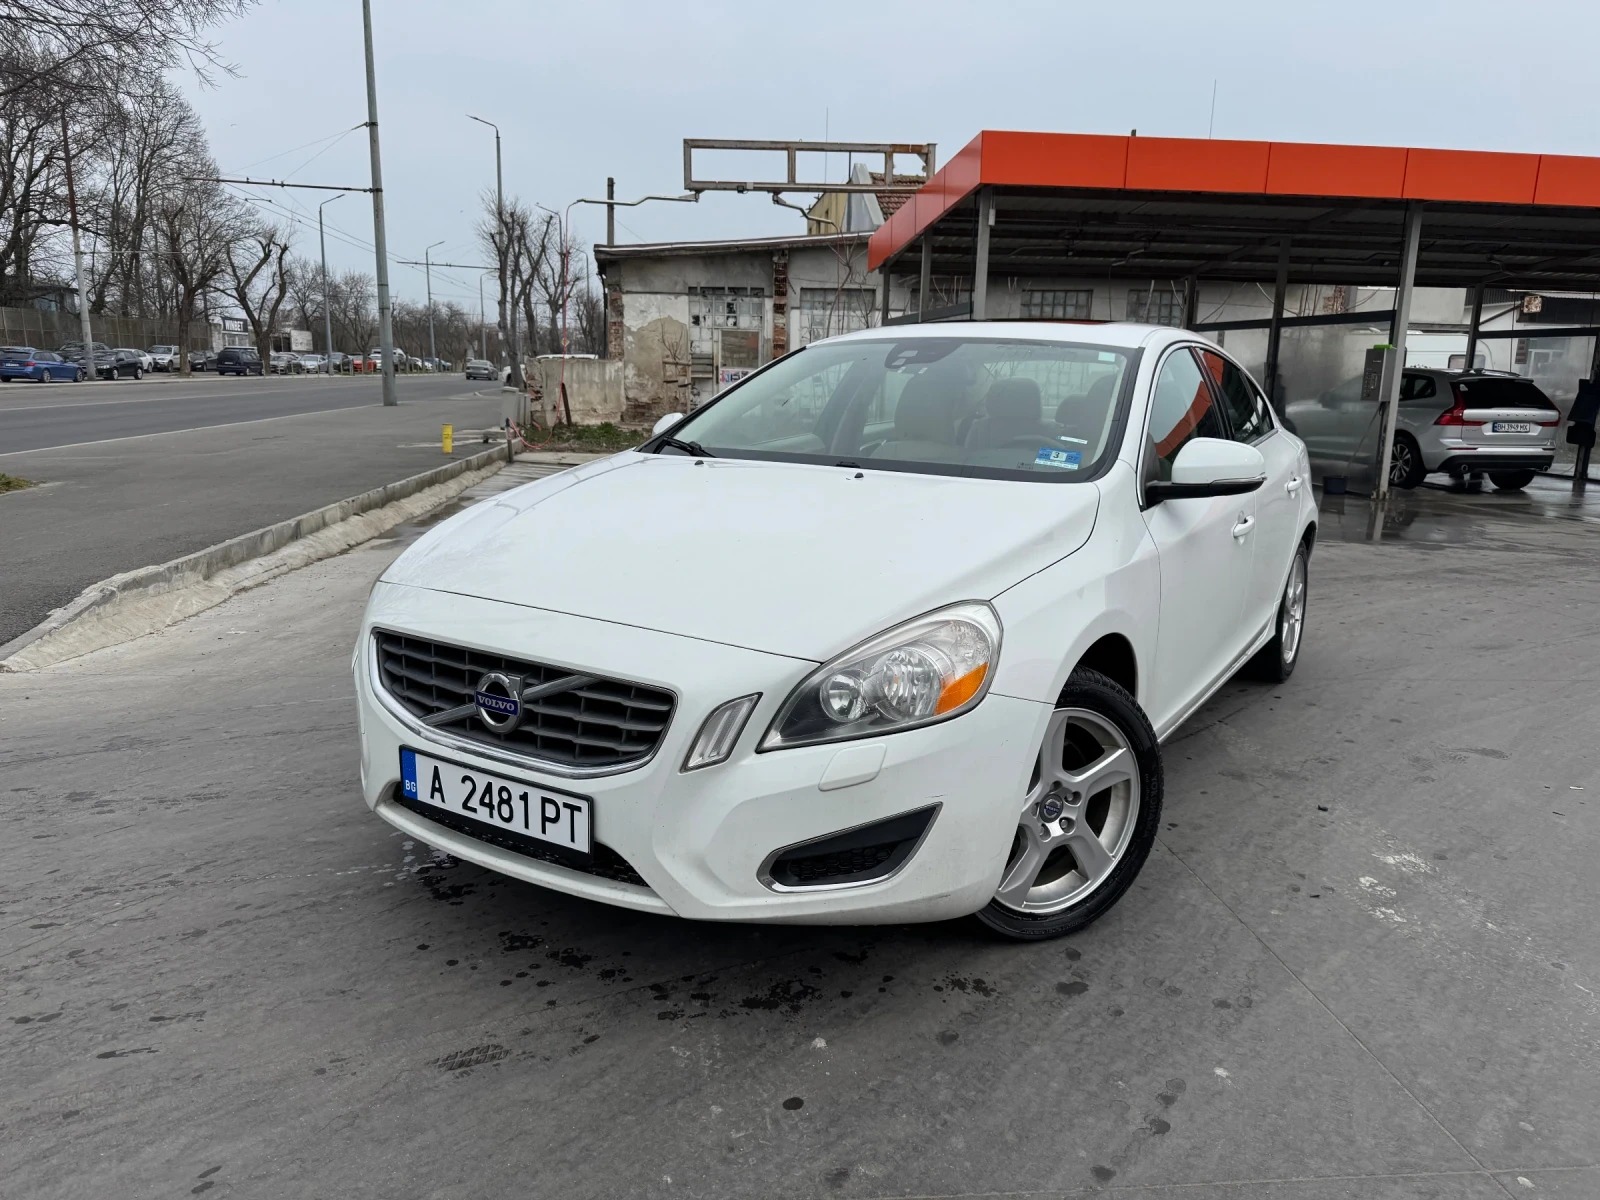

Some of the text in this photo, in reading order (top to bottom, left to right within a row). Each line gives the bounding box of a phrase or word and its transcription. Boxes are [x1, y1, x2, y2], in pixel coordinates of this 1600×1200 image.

[224, 320, 244, 331] WINBET
[1053, 451, 1060, 459] 3
[477, 694, 515, 712] VOLVO
[405, 779, 416, 792] BG
[430, 765, 582, 843] A 2481 PT
